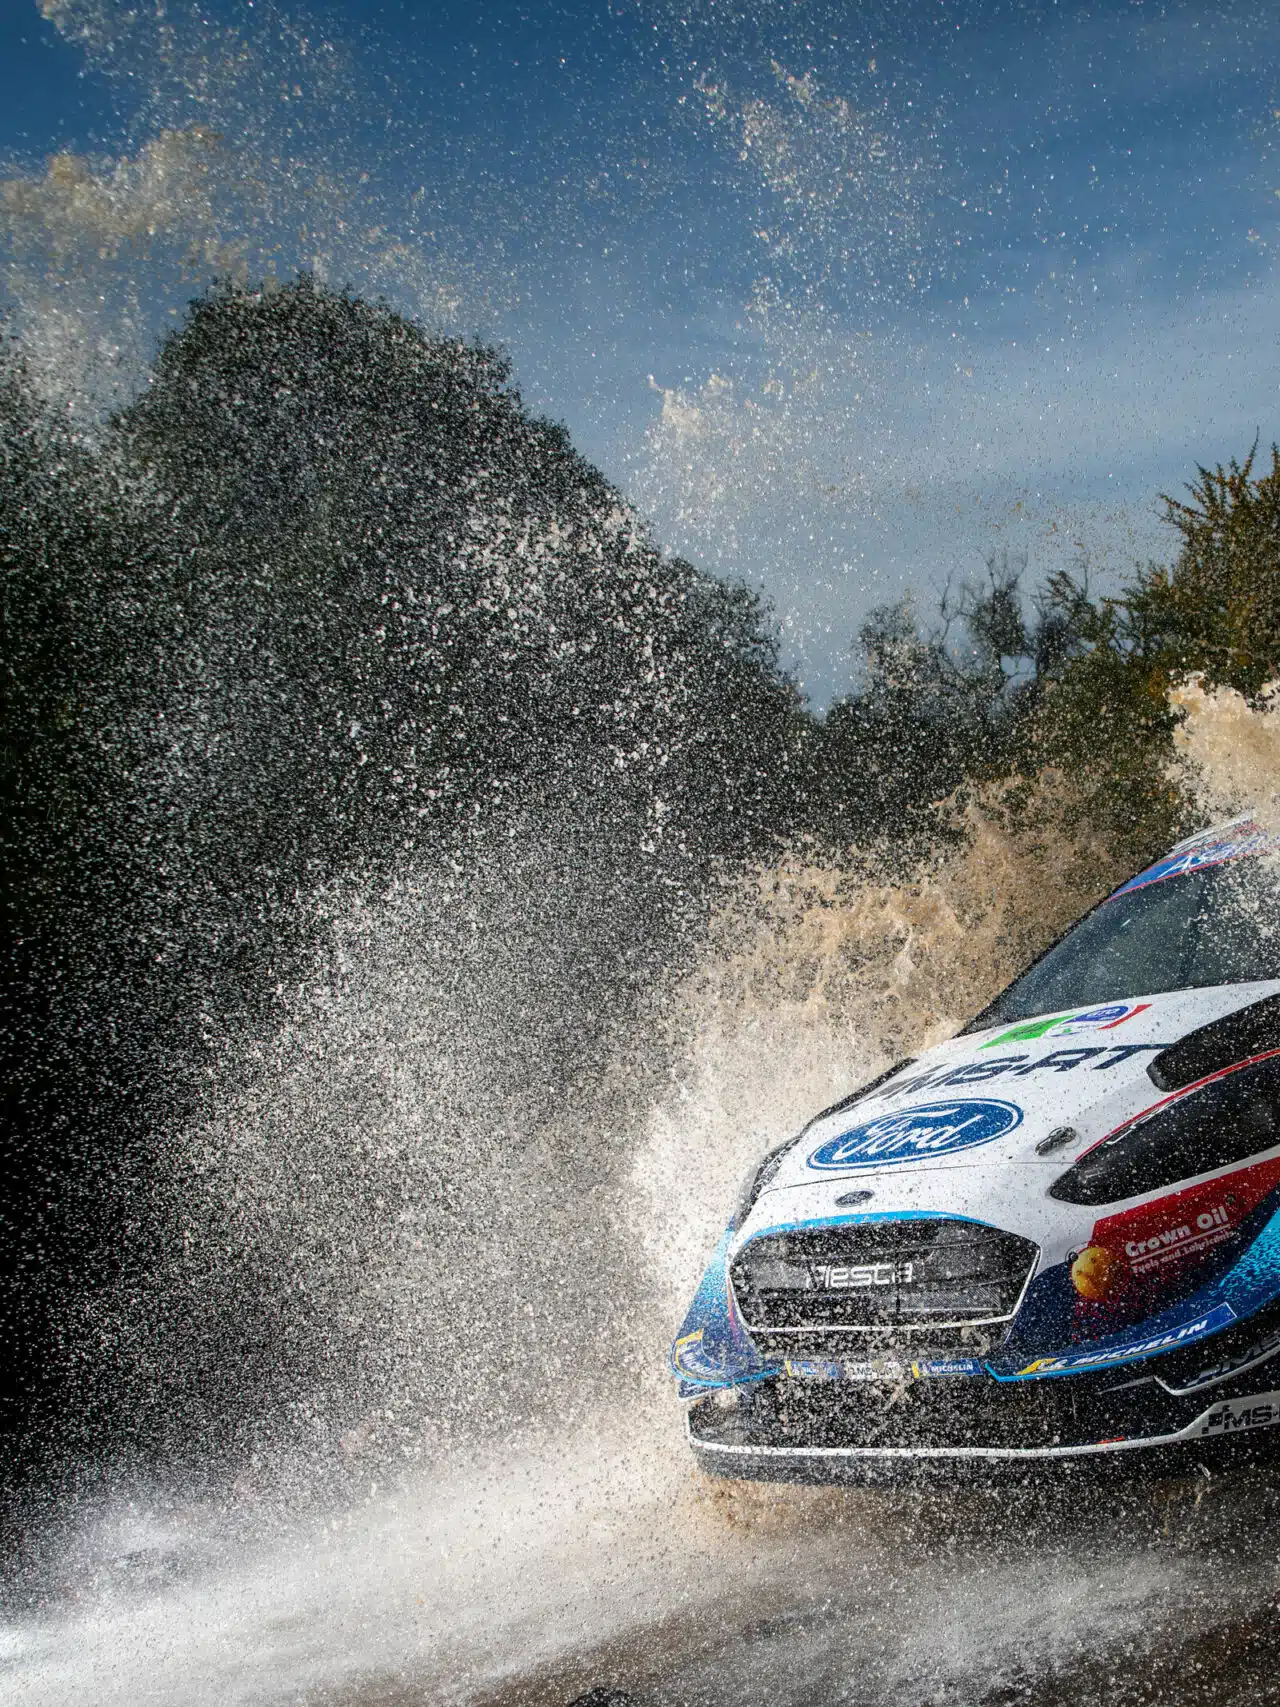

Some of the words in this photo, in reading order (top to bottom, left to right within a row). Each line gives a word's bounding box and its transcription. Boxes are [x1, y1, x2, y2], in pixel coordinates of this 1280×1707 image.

[832, 1105, 985, 1161] Ford
[1125, 1225, 1192, 1257] Crown
[1196, 1205, 1229, 1230] Oil
[1071, 1319, 1208, 1366] MICHELIN
